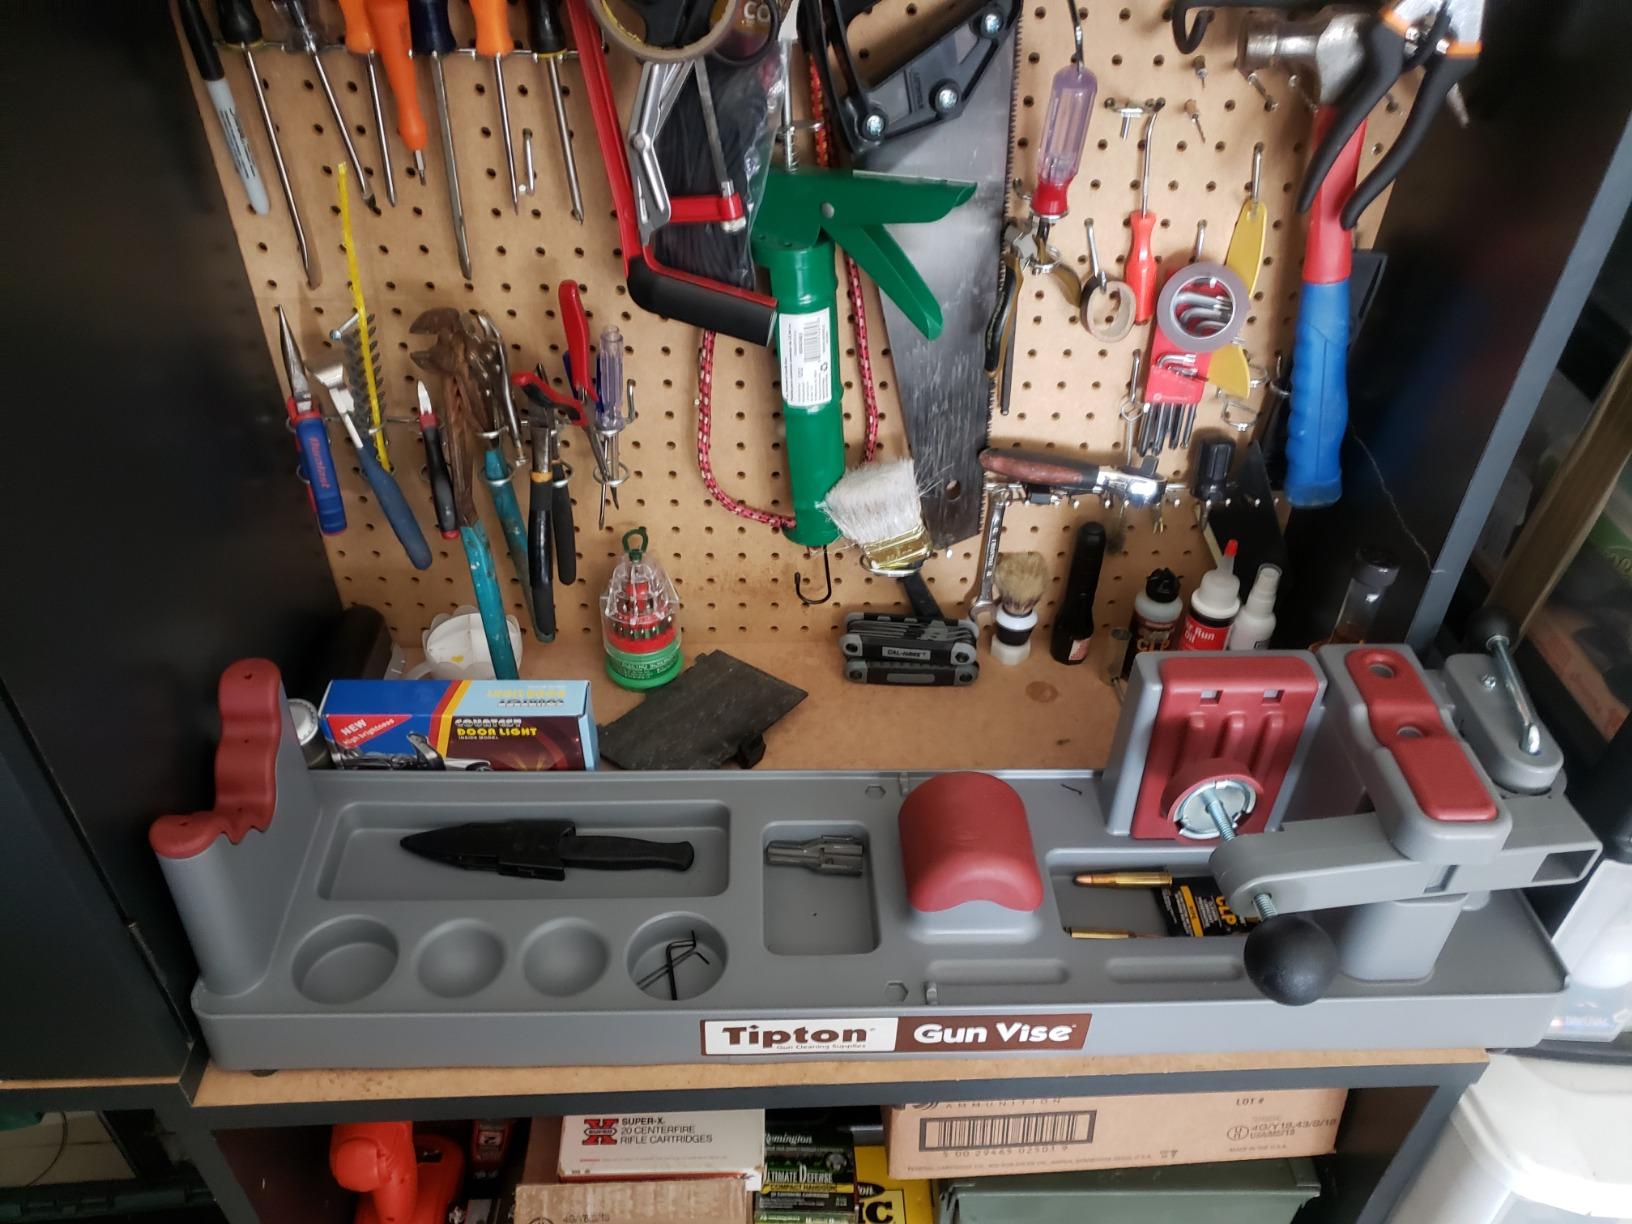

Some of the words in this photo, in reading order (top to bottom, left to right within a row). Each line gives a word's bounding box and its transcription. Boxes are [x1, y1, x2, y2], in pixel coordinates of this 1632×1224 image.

[340, 718, 367, 736] NEW
[456, 727, 497, 736] DOOR
[499, 727, 538, 736] LIGHT
[722, 1025, 867, 1049] Tipton
[913, 1023, 988, 1044] Gun
[996, 1022, 1074, 1042] Vise
[1235, 1097, 1254, 1106] LOT
[620, 1126, 633, 1135] 20
[634, 1125, 696, 1135] CENTERFIRE
[620, 1135, 649, 1145] RIFLE
[649, 1134, 713, 1144] CARTRIDGES
[800, 1162, 833, 1184] DEFENSE
